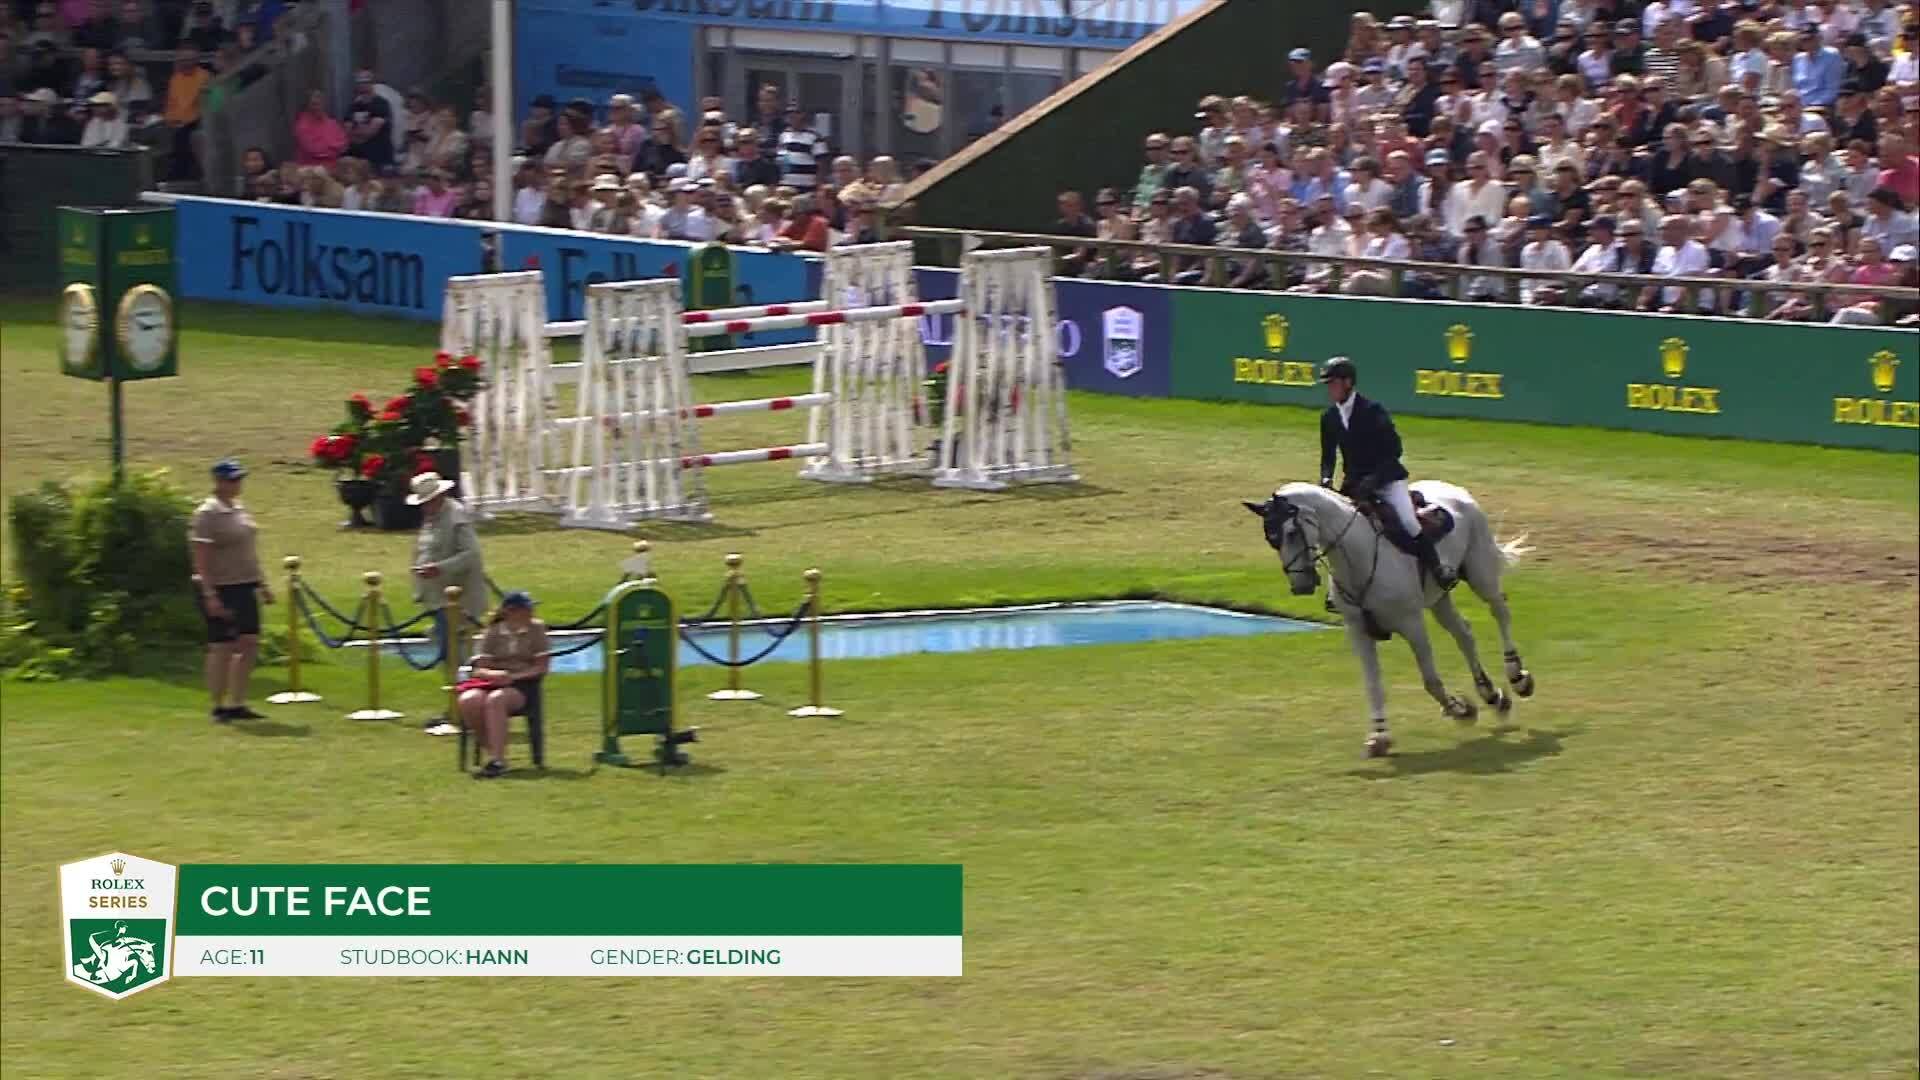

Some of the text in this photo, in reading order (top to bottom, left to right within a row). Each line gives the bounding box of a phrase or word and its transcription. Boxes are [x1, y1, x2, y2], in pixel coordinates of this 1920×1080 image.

[229, 216, 424, 308] Folksam
[1234, 358, 1317, 386] ROLEX
[1415, 370, 1504, 399] ROLEX
[1626, 384, 1722, 413] ROLEX
